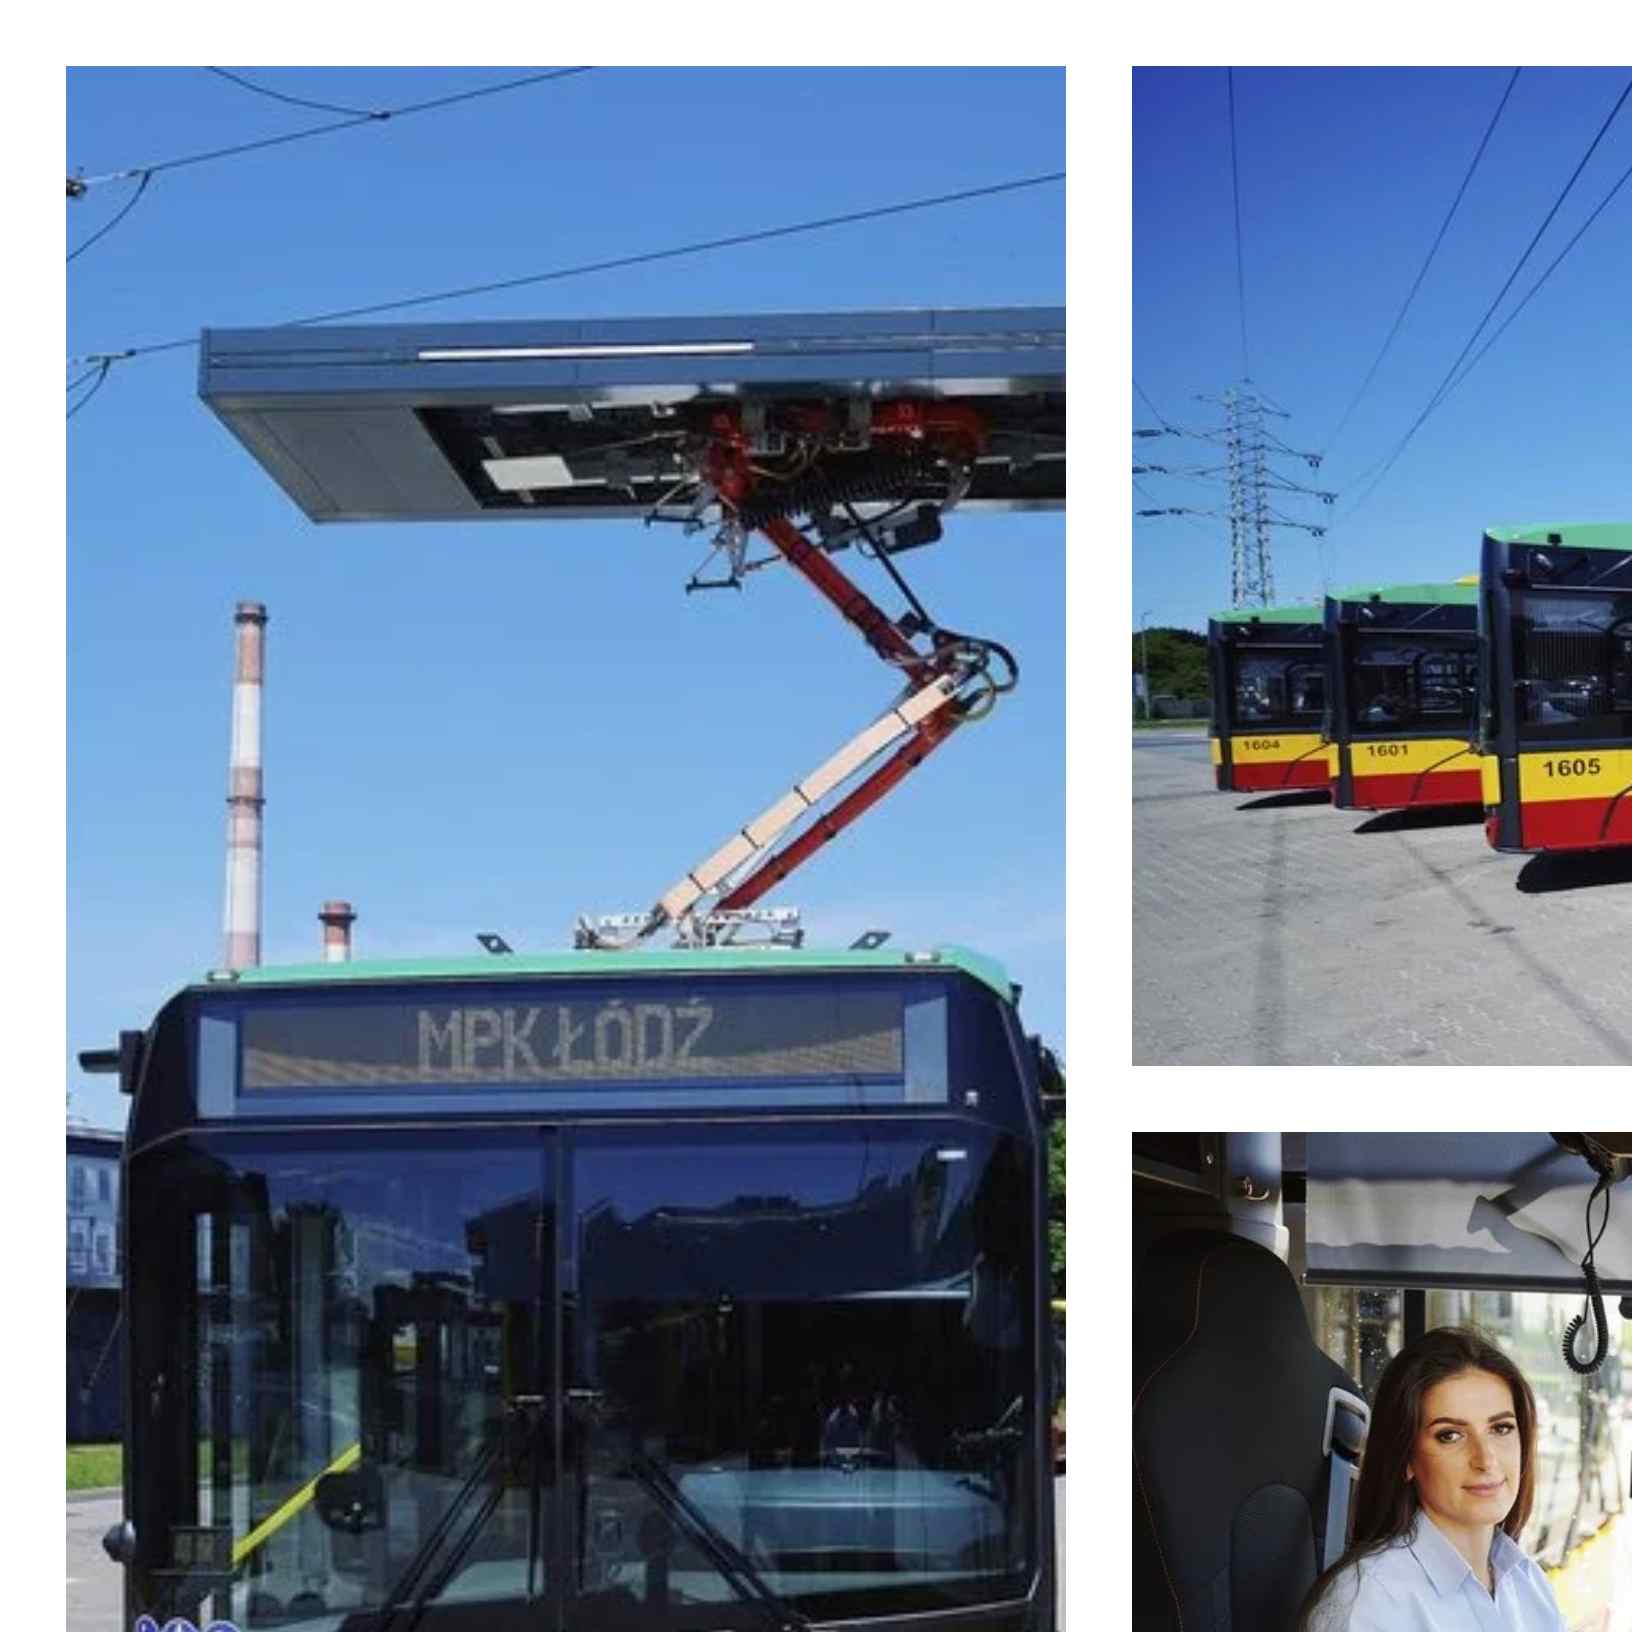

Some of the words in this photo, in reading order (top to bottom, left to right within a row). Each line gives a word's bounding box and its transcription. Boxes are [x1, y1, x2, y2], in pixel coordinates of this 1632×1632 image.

[1368, 744, 1409, 757] 1601
[1543, 758, 1601, 777] 1605
[417, 1007, 543, 1076] MPK
[552, 997, 713, 1074] ŁÓDŹ
